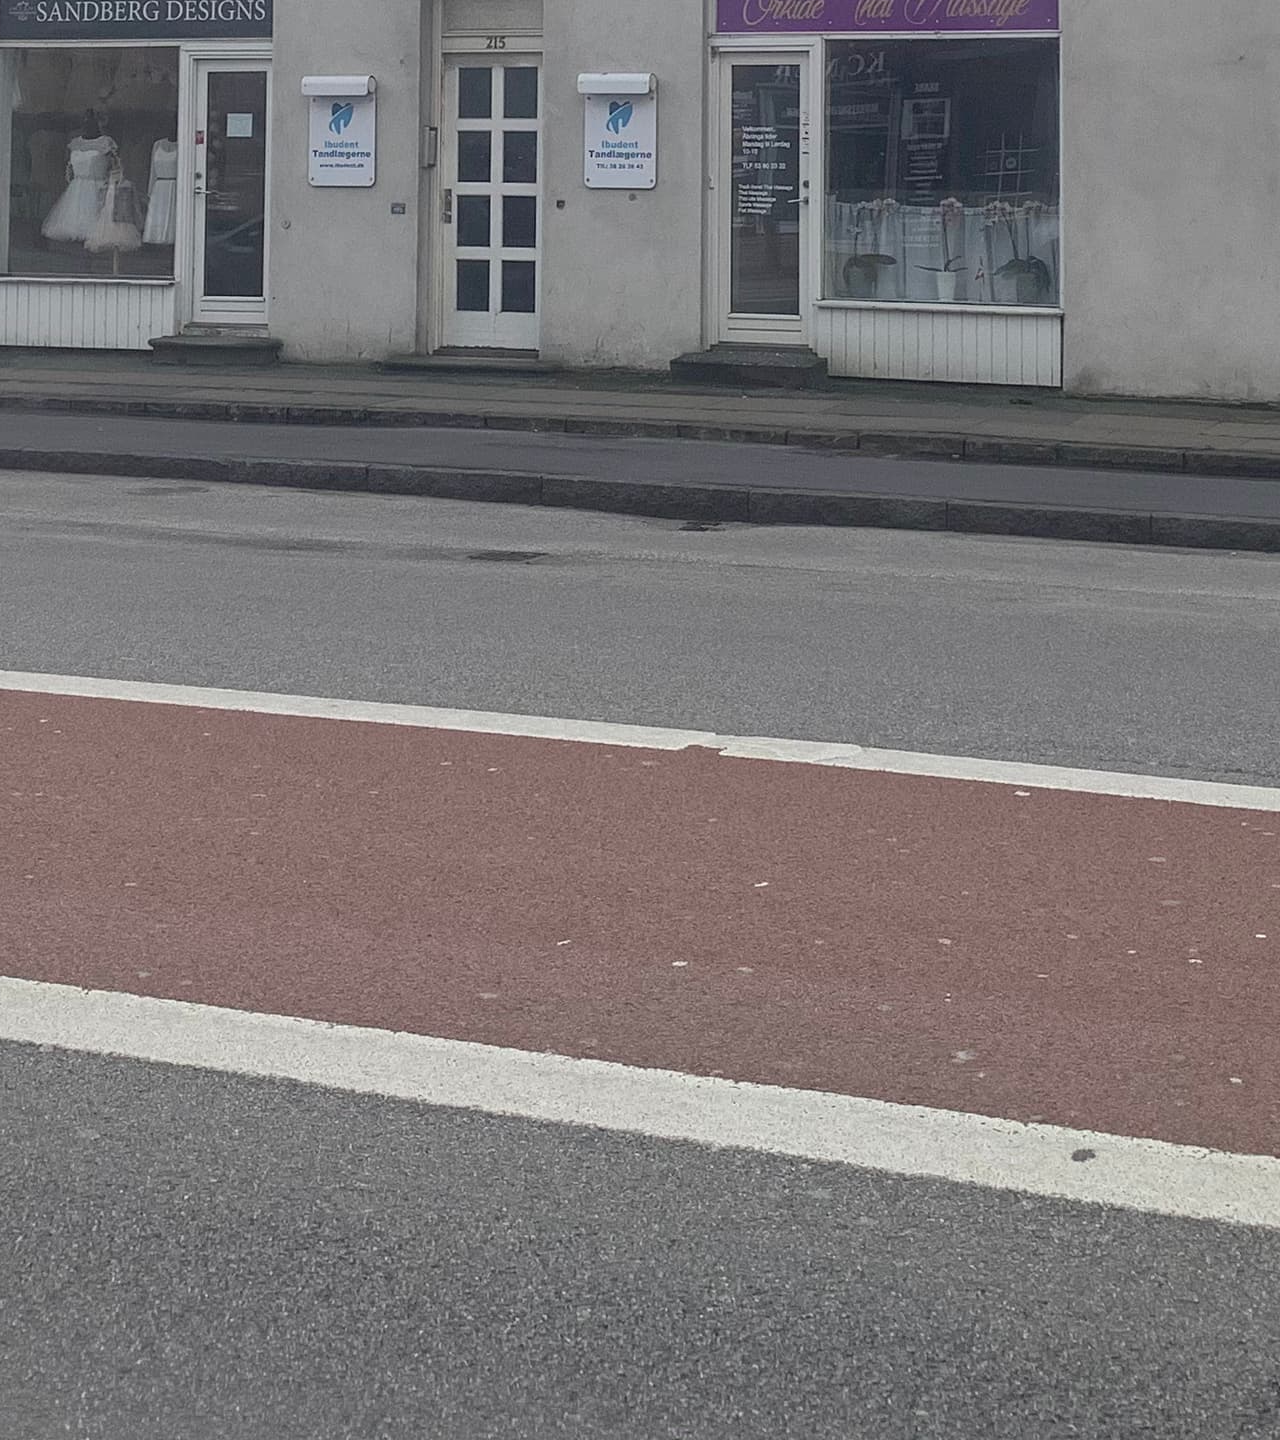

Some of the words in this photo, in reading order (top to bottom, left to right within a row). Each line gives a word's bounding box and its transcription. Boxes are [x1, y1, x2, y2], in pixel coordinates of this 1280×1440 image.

[36, 0, 160, 22] SANDBERG
[165, 0, 266, 21] DESIGNS
[485, 36, 506, 49] 215
[324, 141, 359, 149] Ibudent
[601, 141, 639, 149] Ibudent
[312, 150, 371, 160] Tandlægerne
[588, 150, 653, 160] Tandlægerne
